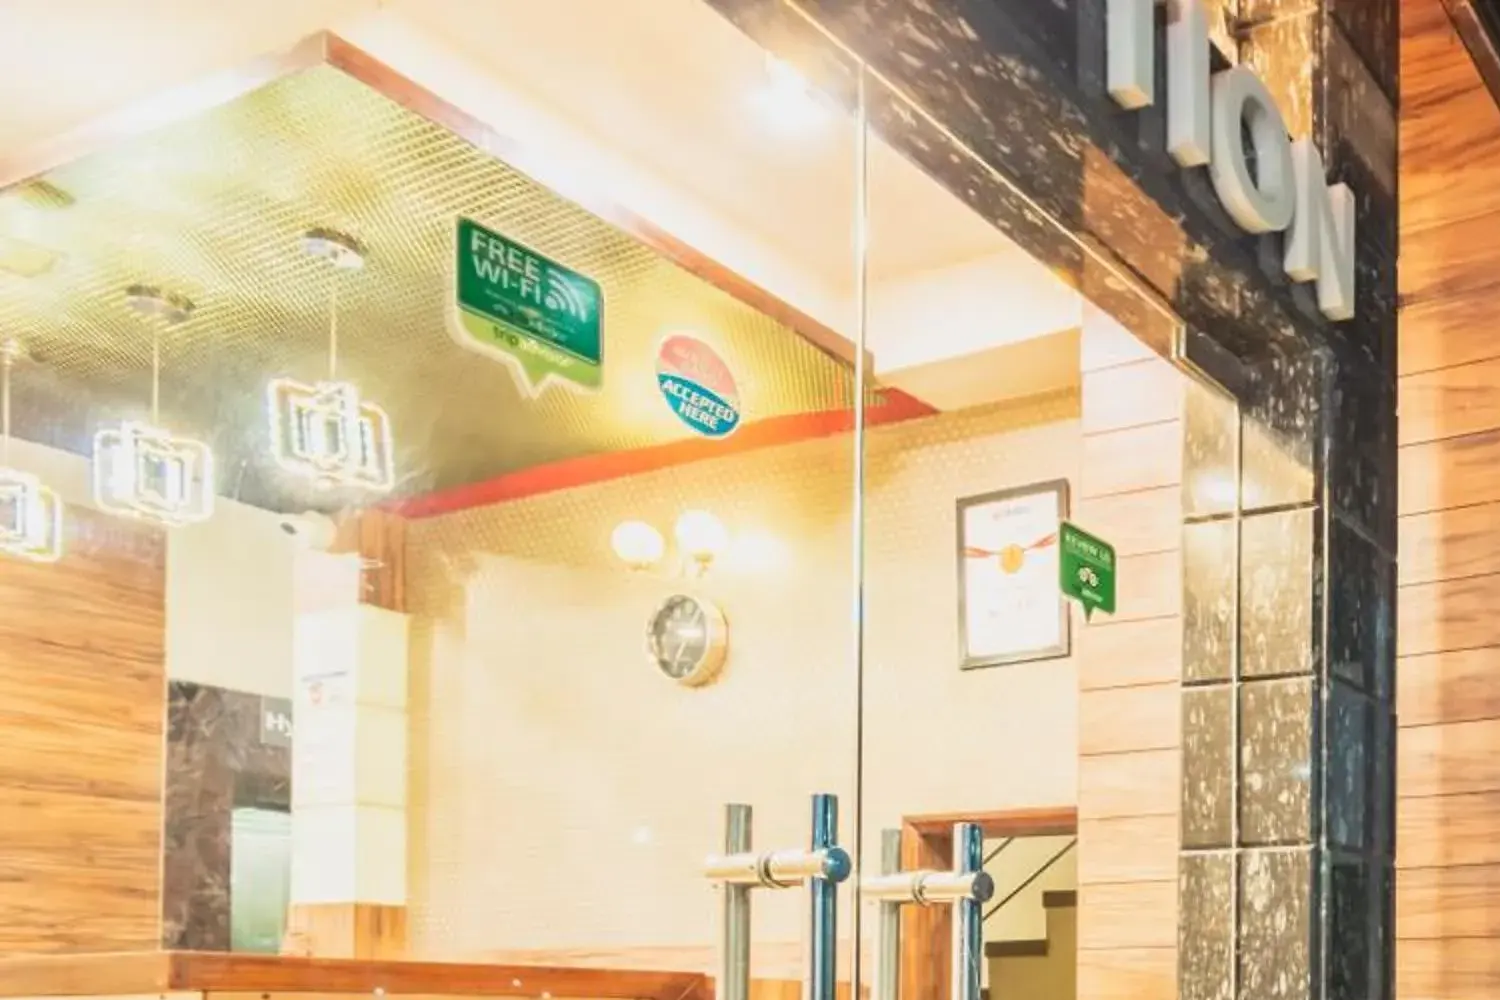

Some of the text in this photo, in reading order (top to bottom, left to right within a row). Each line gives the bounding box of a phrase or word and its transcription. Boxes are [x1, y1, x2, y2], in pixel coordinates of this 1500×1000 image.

[471, 229, 541, 283] FREE
[472, 254, 541, 305] WI-FI
[660, 379, 735, 423] ACCEPTED
[679, 400, 718, 430] HERE
